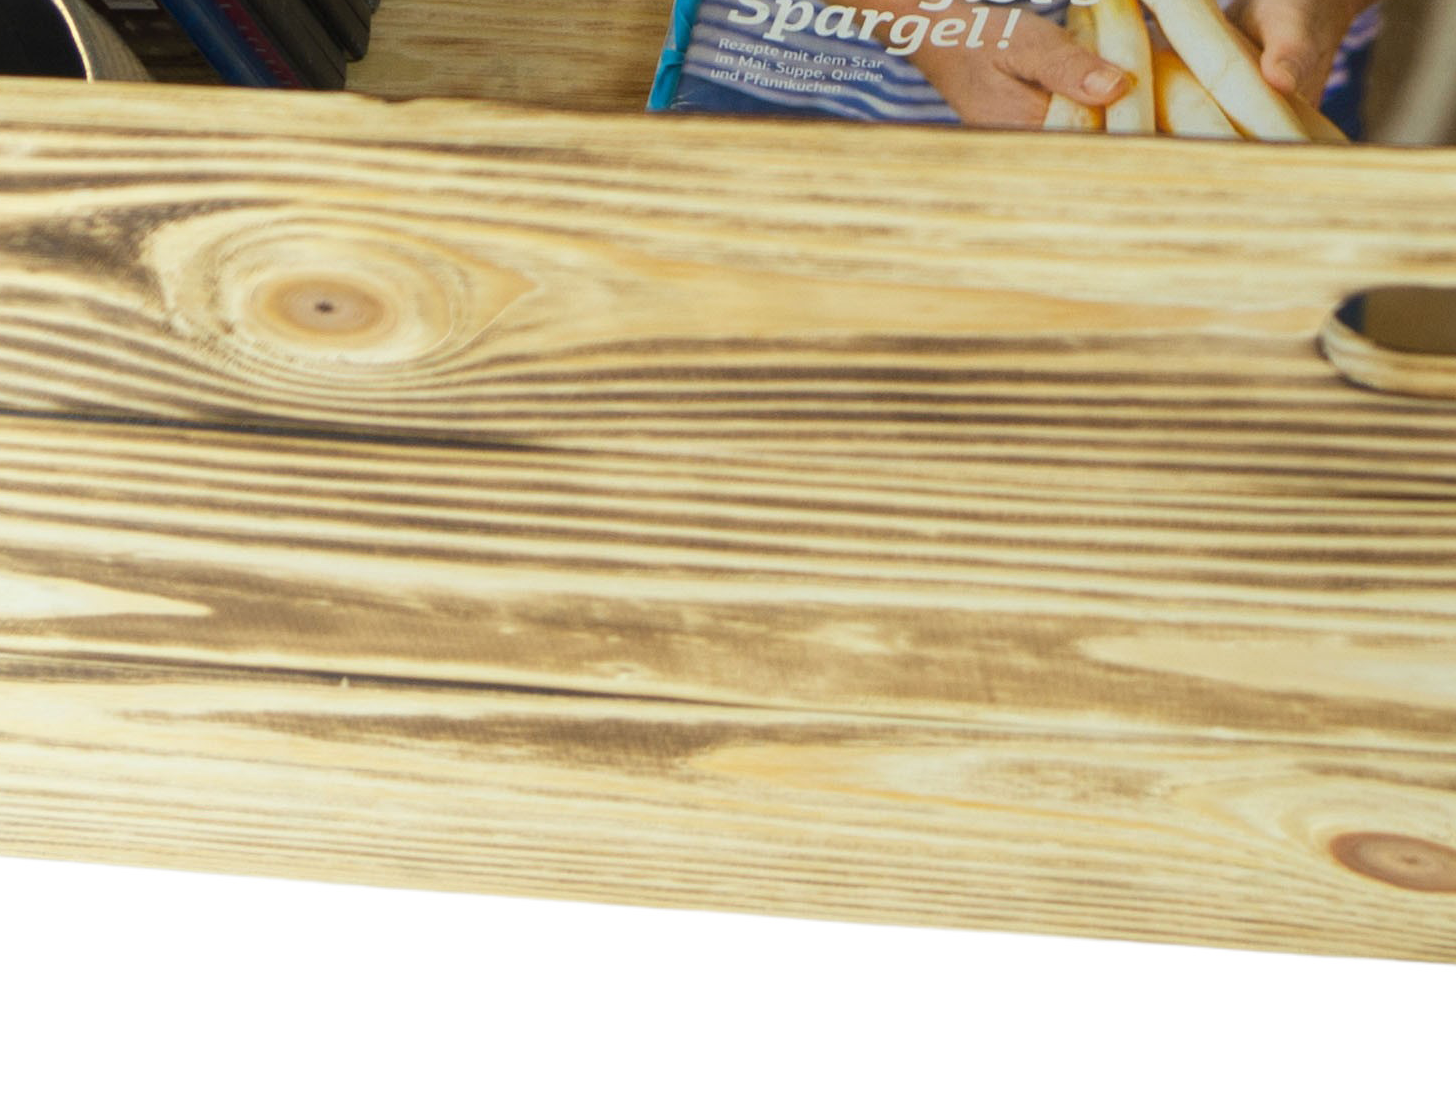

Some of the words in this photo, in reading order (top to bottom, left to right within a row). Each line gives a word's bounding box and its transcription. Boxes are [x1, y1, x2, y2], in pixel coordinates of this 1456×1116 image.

[714, 52, 734, 65] im
[738, 55, 771, 70] Mai:
[775, 61, 827, 81] Suppe,
[831, 68, 884, 83] Quiche
[718, 38, 780, 57] Rezepte
[783, 48, 809, 63] mit
[813, 52, 847, 67] dem
[851, 56, 885, 69] Star
[710, 68, 740, 82] und
[743, 71, 842, 94] Pfannkuchen
